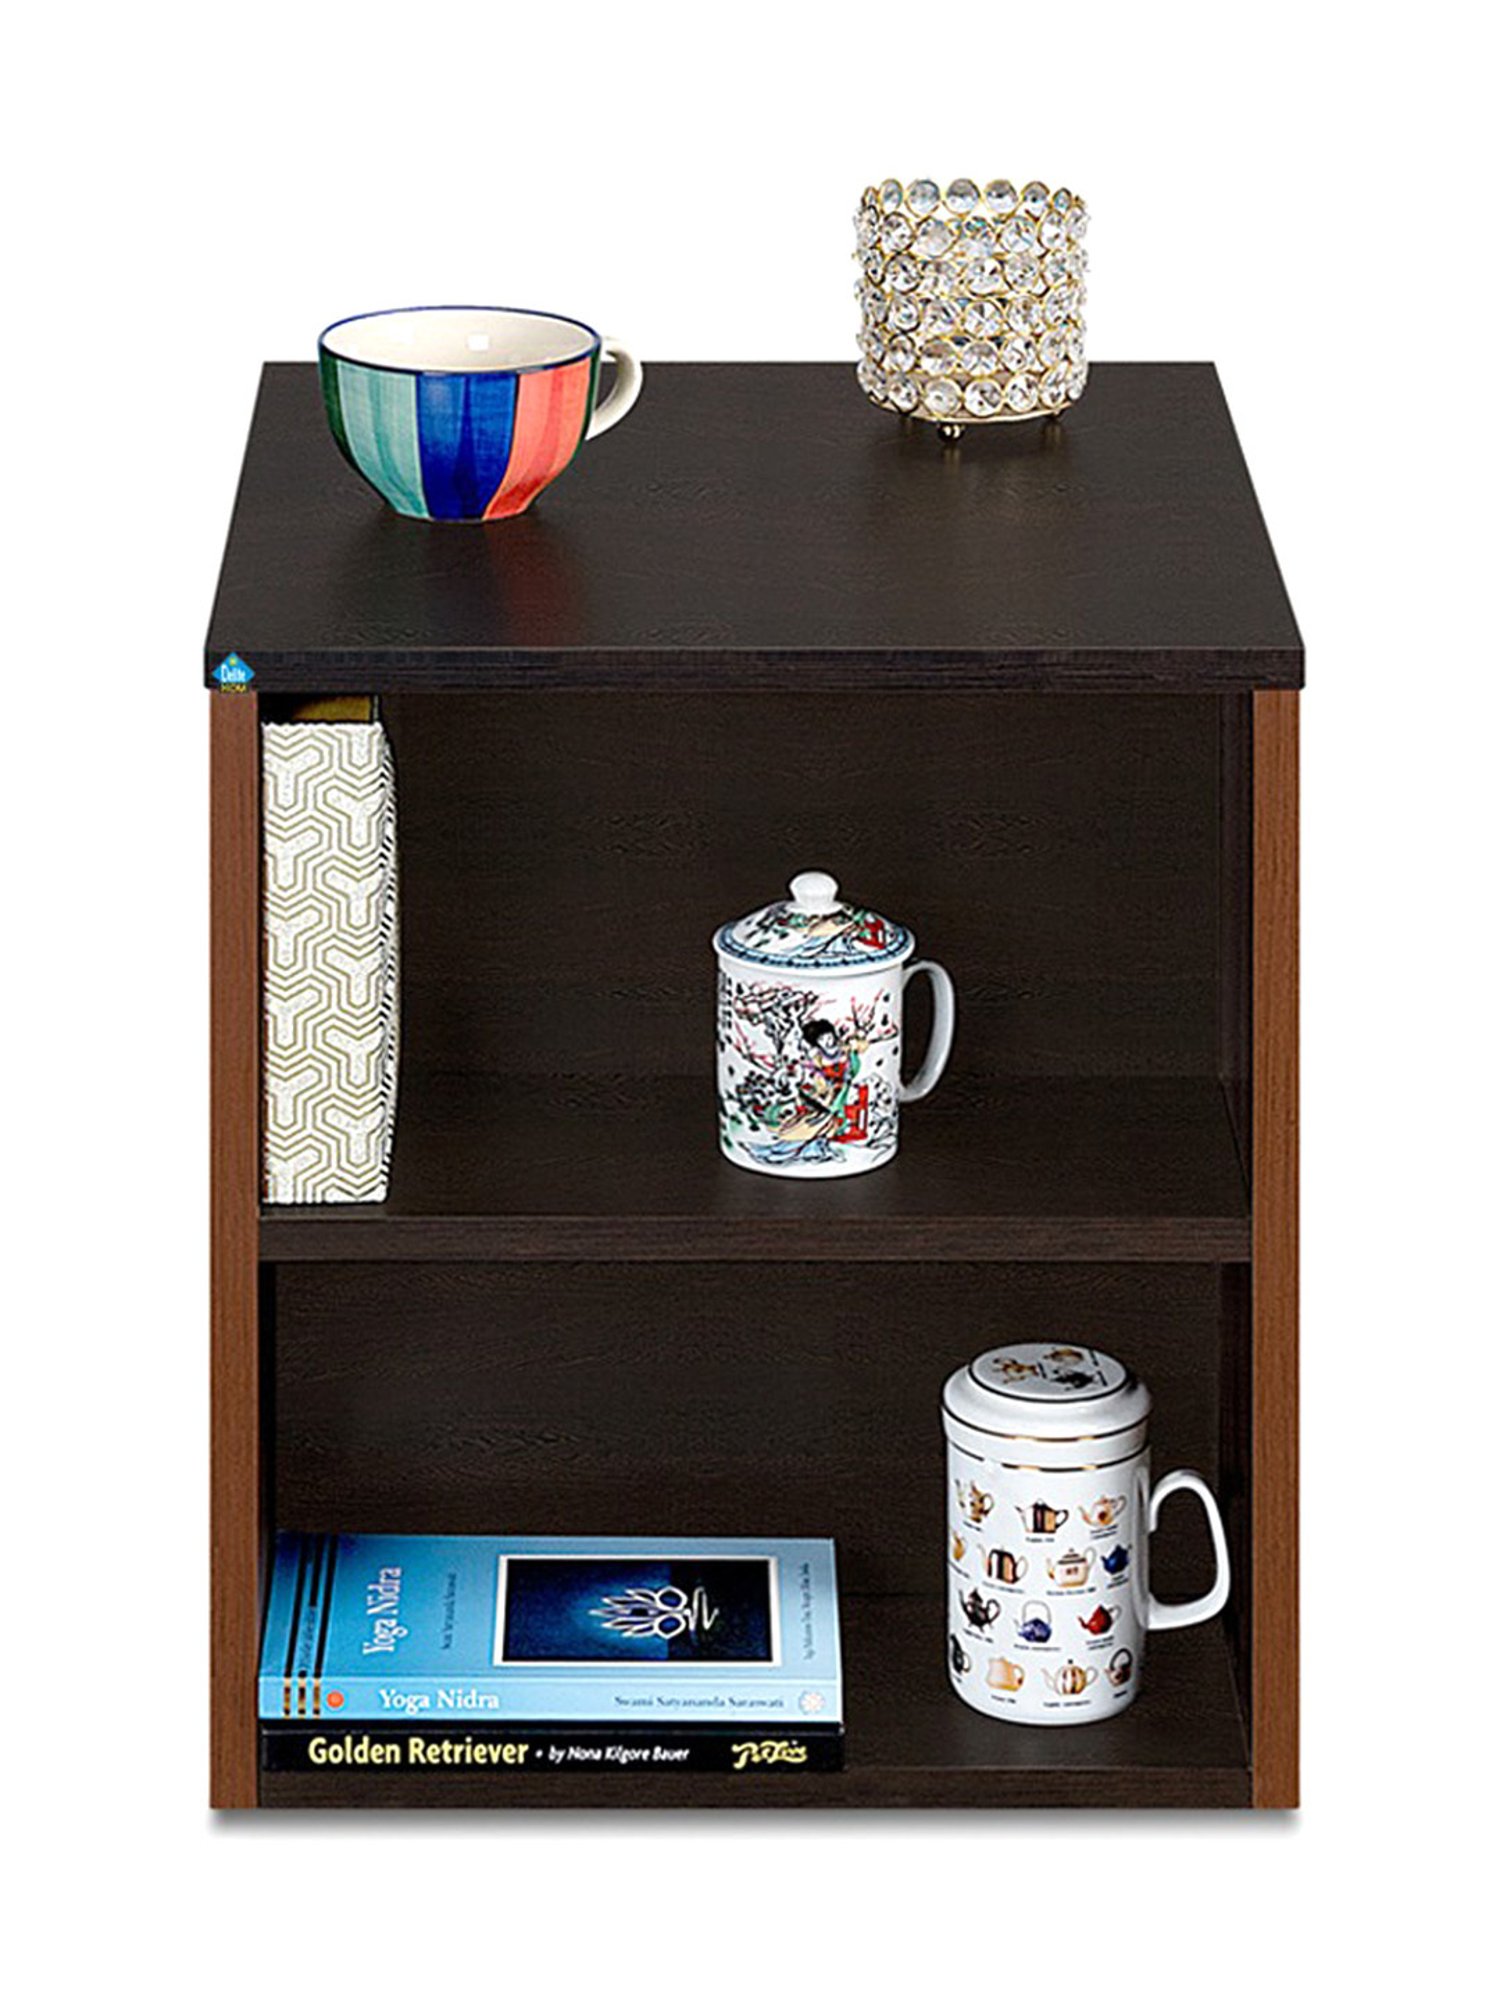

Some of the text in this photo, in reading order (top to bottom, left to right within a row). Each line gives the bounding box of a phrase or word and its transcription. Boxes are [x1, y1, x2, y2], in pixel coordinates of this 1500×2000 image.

[363, 1568, 407, 1654] Yoga Nidra
[379, 1689, 499, 1715] Yoga Nidra
[308, 1736, 690, 1765] Golden Retriever by Nona Kilgore Bauer
